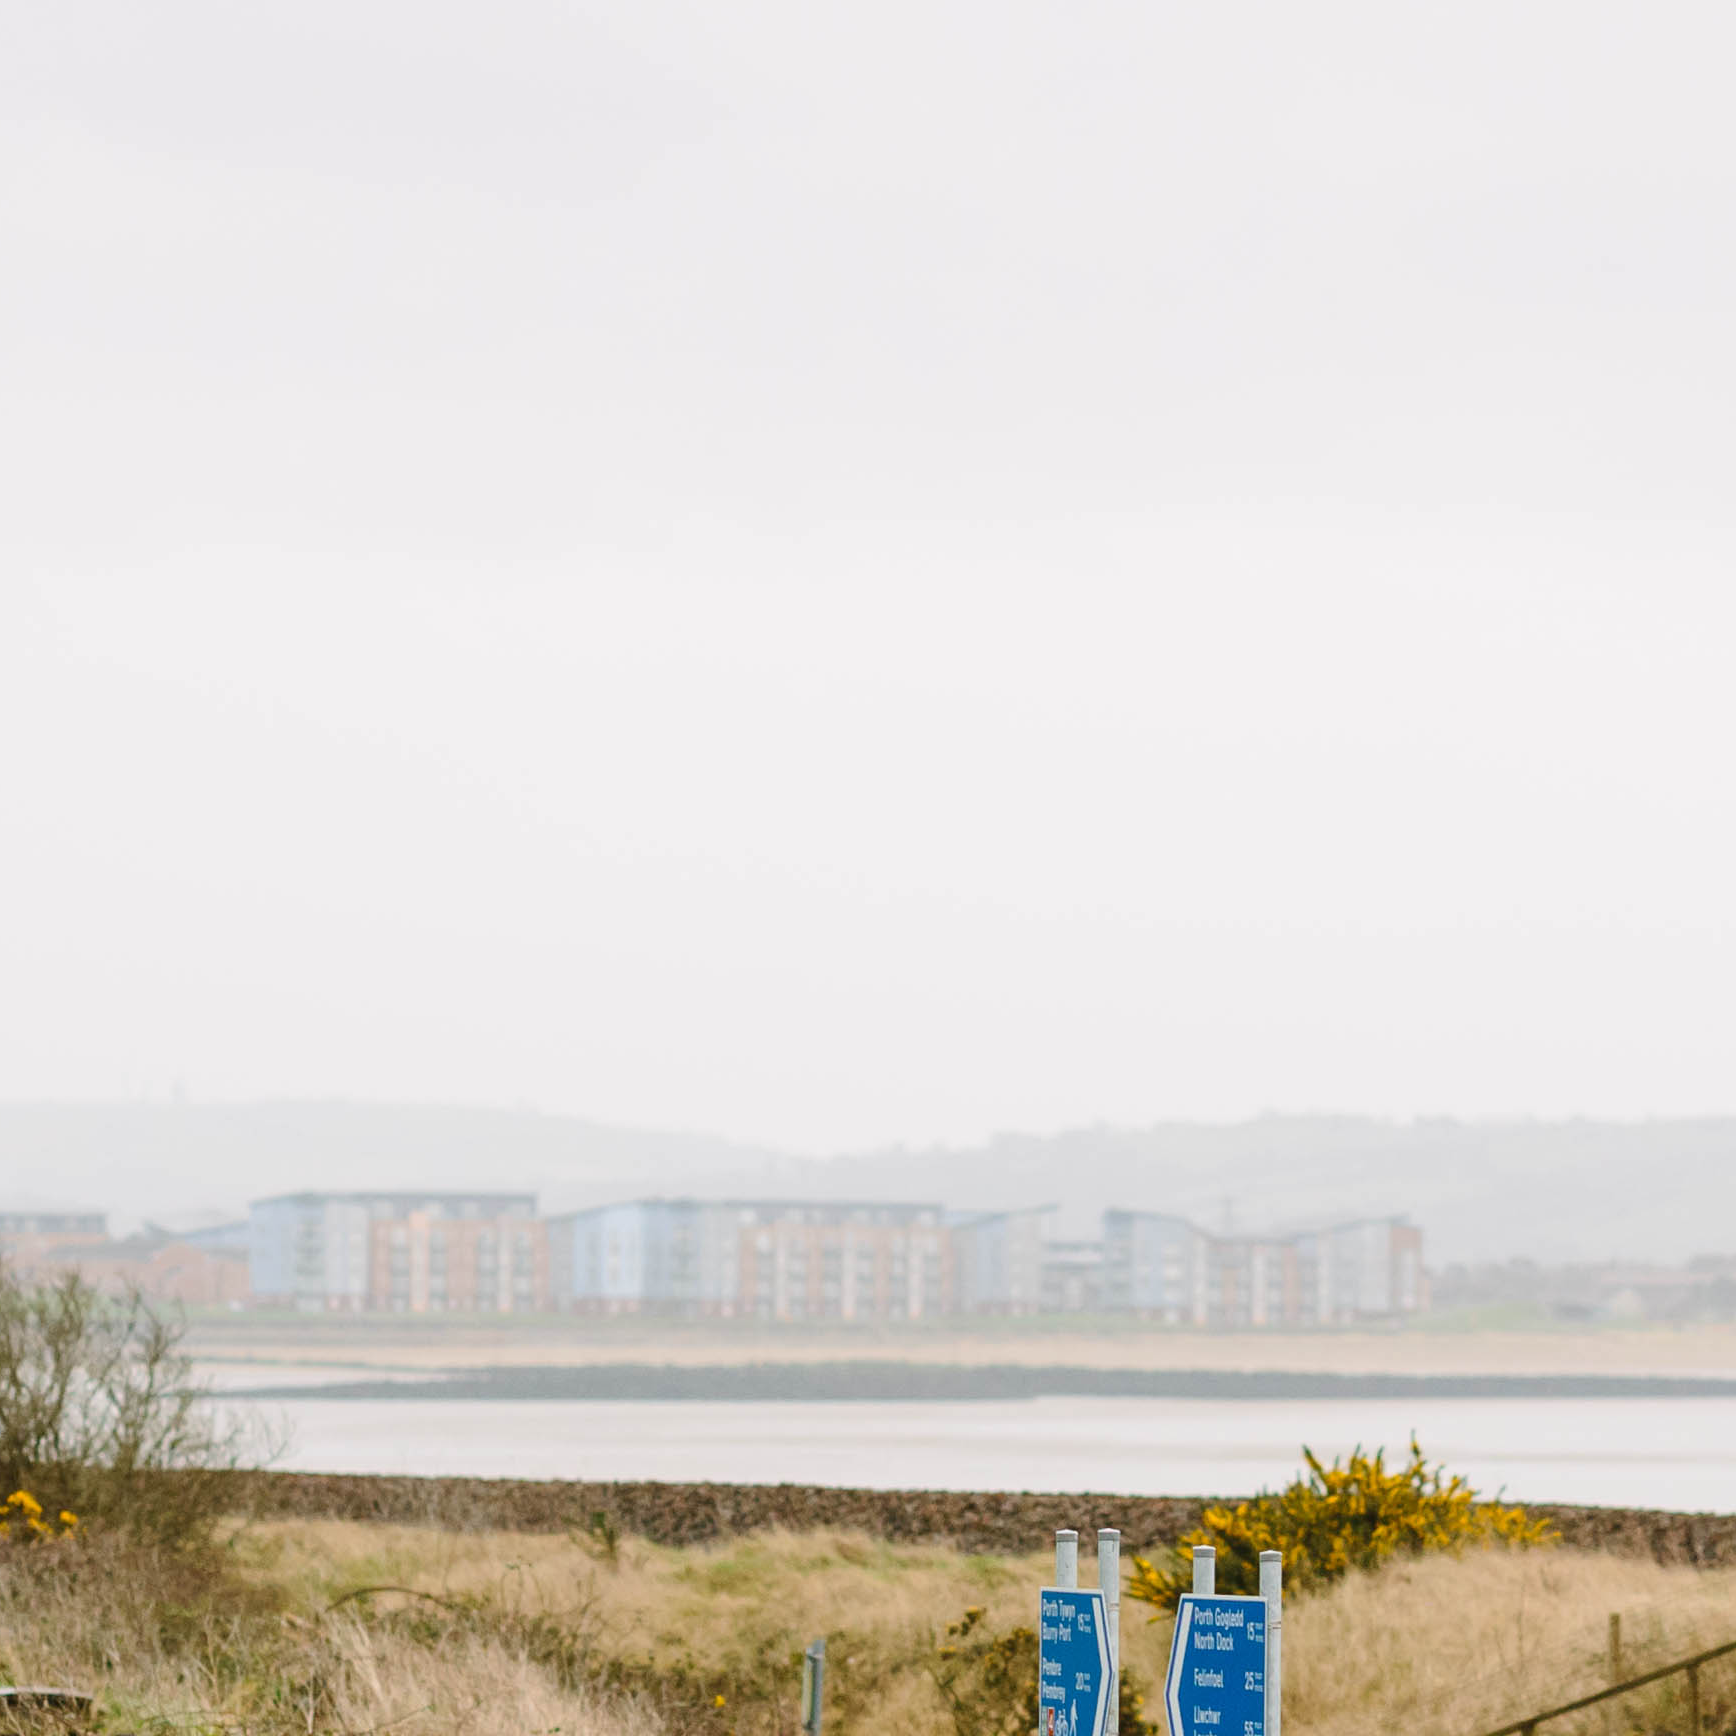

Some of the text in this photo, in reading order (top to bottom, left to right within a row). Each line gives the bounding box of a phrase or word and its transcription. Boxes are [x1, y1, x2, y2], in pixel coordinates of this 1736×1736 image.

[1077, 1613, 1084, 1632] 15
[1194, 1606, 1244, 1631] Porth Gogledd
[1194, 1631, 1215, 1650] North
[1216, 1631, 1234, 1651] Dock
[1247, 1622, 1255, 1641] 15
[1244, 1671, 1254, 1691] 25
